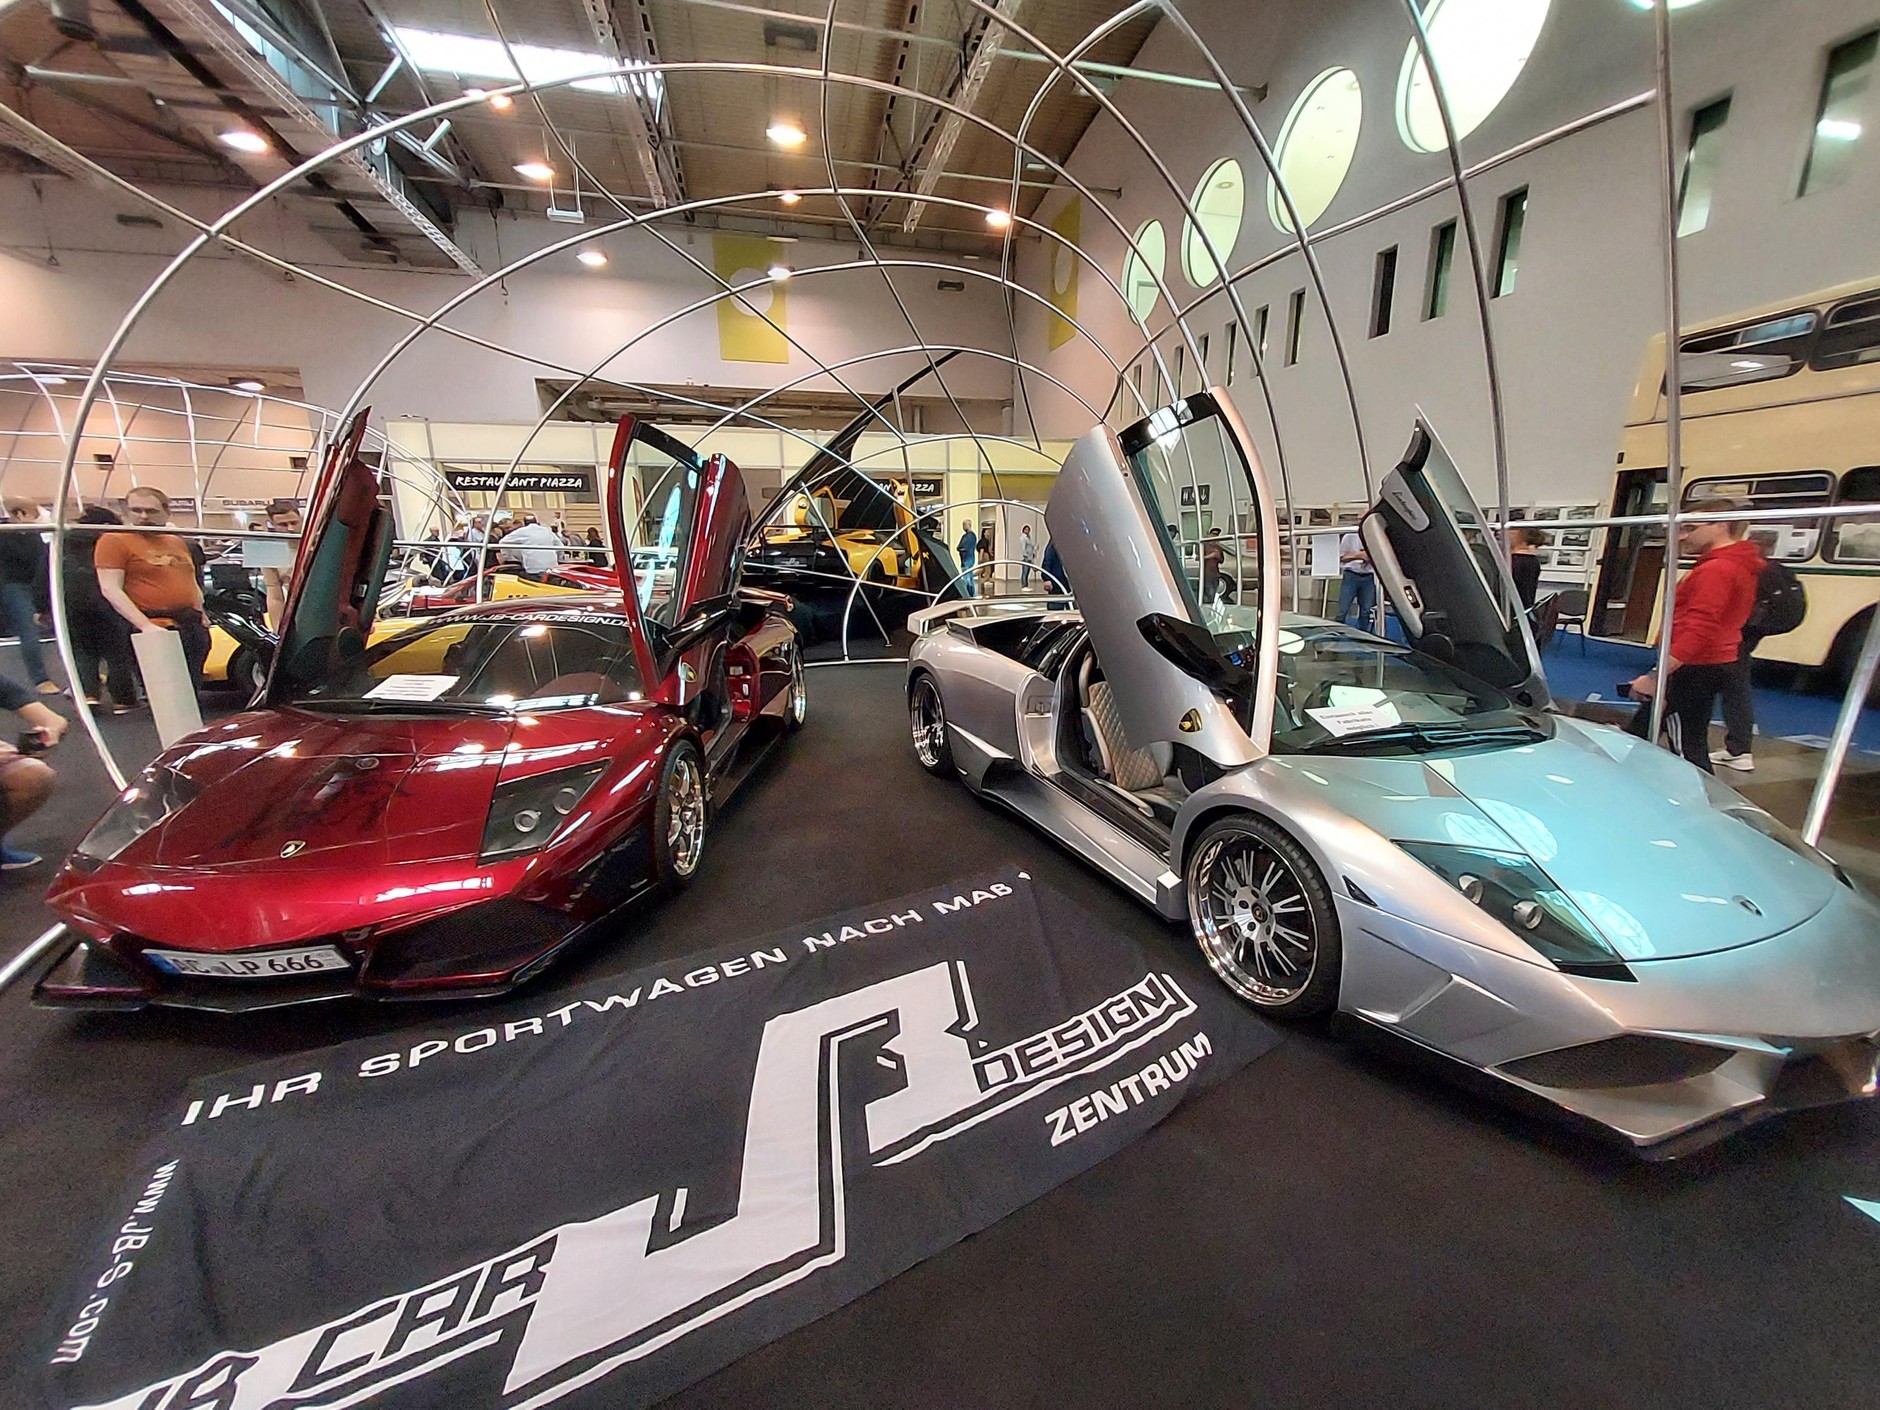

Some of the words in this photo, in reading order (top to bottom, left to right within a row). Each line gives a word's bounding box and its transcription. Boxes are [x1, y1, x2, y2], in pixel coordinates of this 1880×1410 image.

[540, 477, 583, 488] PIAZZA
[180, 1071, 323, 1127] IHR
[358, 947, 788, 1078] SPORTWAGEN
[802, 909, 924, 954] NACH
[267, 954, 324, 973] 666
[1044, 1031, 1214, 1147] ZENTRUM
[286, 1233, 560, 1395] CAR
[971, 978, 1170, 1094] DESIGN
